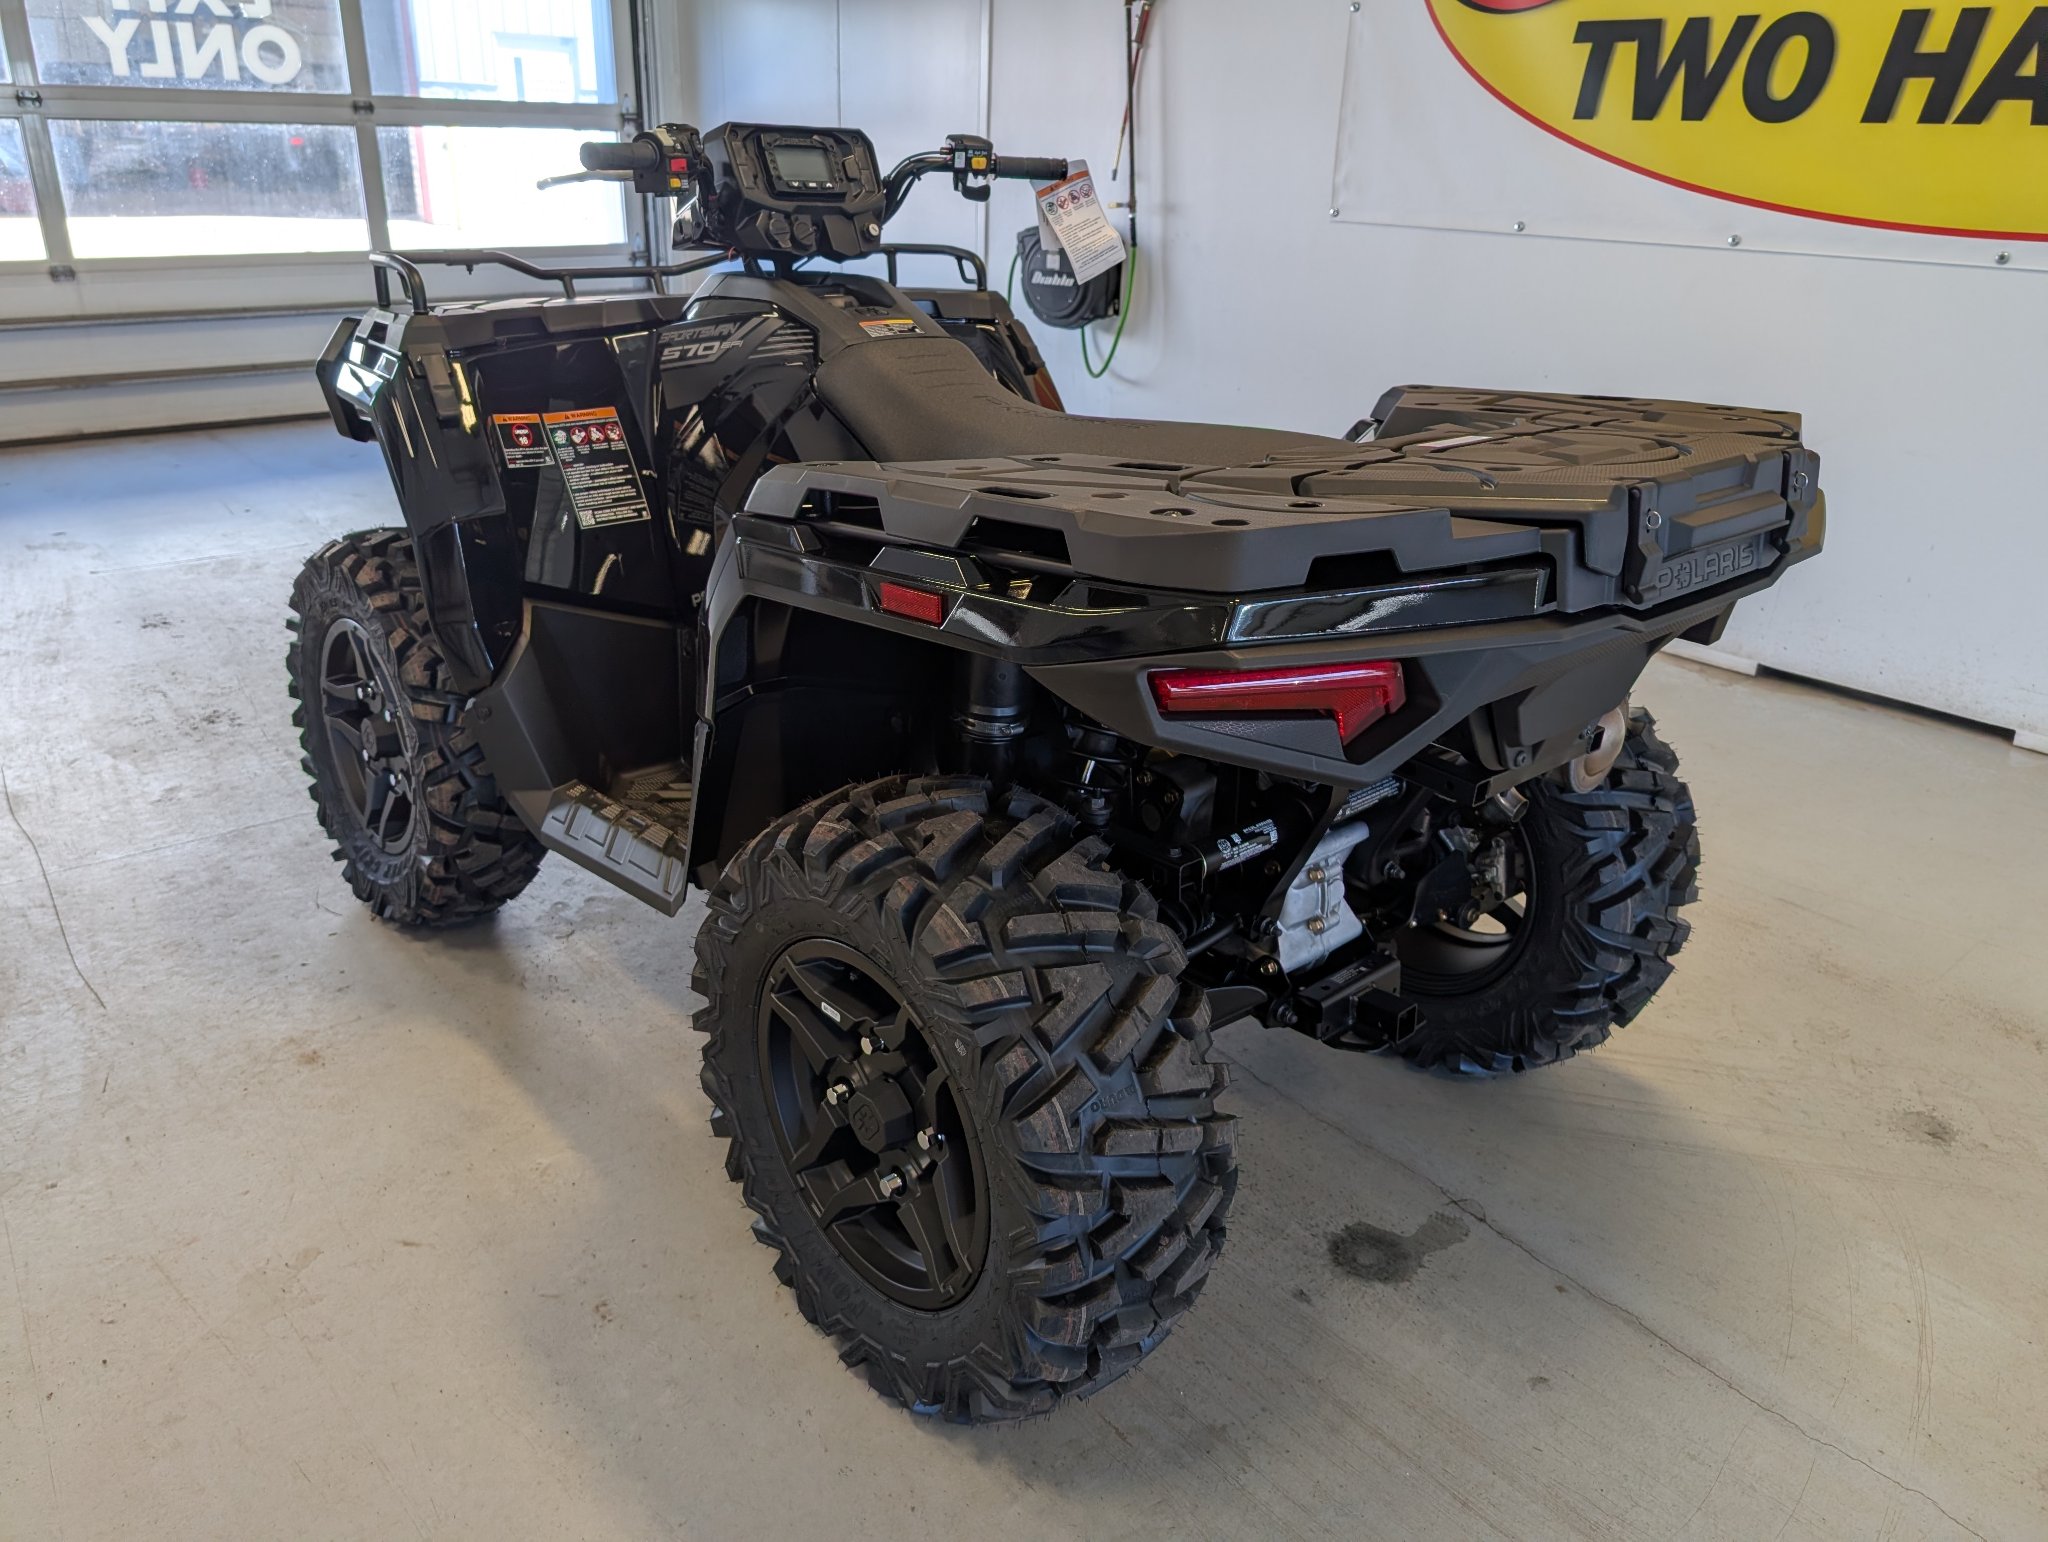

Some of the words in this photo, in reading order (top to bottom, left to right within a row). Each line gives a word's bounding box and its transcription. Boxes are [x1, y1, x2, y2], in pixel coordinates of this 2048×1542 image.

[1572, 12, 1837, 124] TWO
[659, 322, 743, 343] SPORTSMAN
[661, 341, 720, 361] 570
[720, 339, 745, 350] EFI
[1657, 543, 1755, 597] POLARIS
